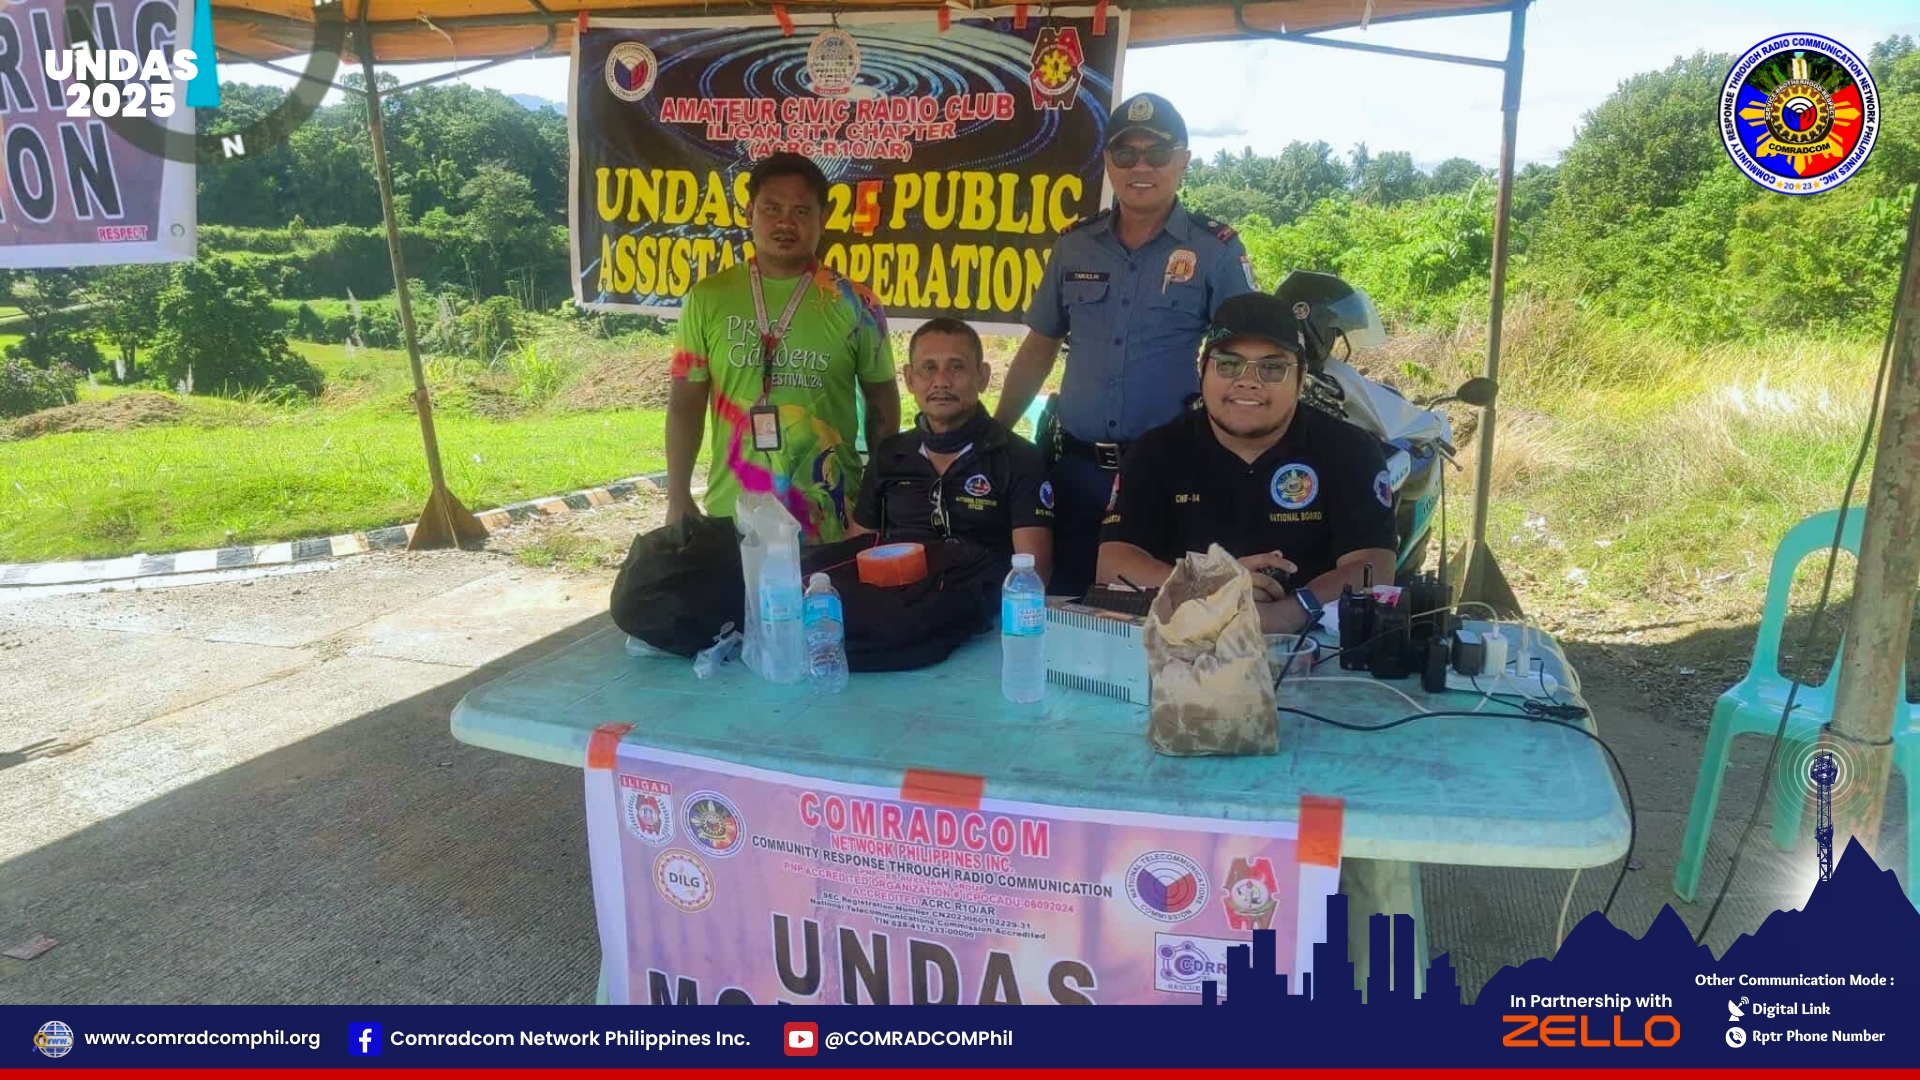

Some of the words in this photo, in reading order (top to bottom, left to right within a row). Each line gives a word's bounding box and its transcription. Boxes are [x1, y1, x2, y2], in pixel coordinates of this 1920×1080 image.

[660, 97, 777, 123] AMATEUR
[781, 98, 849, 123] CIVIC
[857, 97, 938, 122] RADIO
[943, 94, 1014, 121] CLUB
[706, 124, 781, 140] ILIGAN
[787, 123, 840, 140] CITY
[846, 122, 956, 141] CHAPTER
[889, 171, 1083, 234] PUBLIC
[98, 225, 148, 240] RESPECT
[621, 776, 671, 794] ILIGAN
[799, 791, 1050, 859] COMRADCOM
[752, 835, 820, 859] COMMUNITY
[823, 850, 885, 871] RESPONSE
[888, 860, 951, 880] THROUGH
[954, 869, 994, 885] RADIO
[998, 875, 1113, 898] COMMUNICATION
[830, 832, 893, 857] NETWORK
[895, 843, 982, 871] PHILIPPINES
[986, 853, 1015, 873] INC.
[669, 872, 701, 888] DILG
[806, 867, 870, 886] ACCREDITED
[872, 878, 950, 898] ORGANIZATION
[1128, 862, 1143, 899] NATIONAL
[920, 898, 952, 911] ACRC
[770, 912, 1100, 1005] UNDAS
